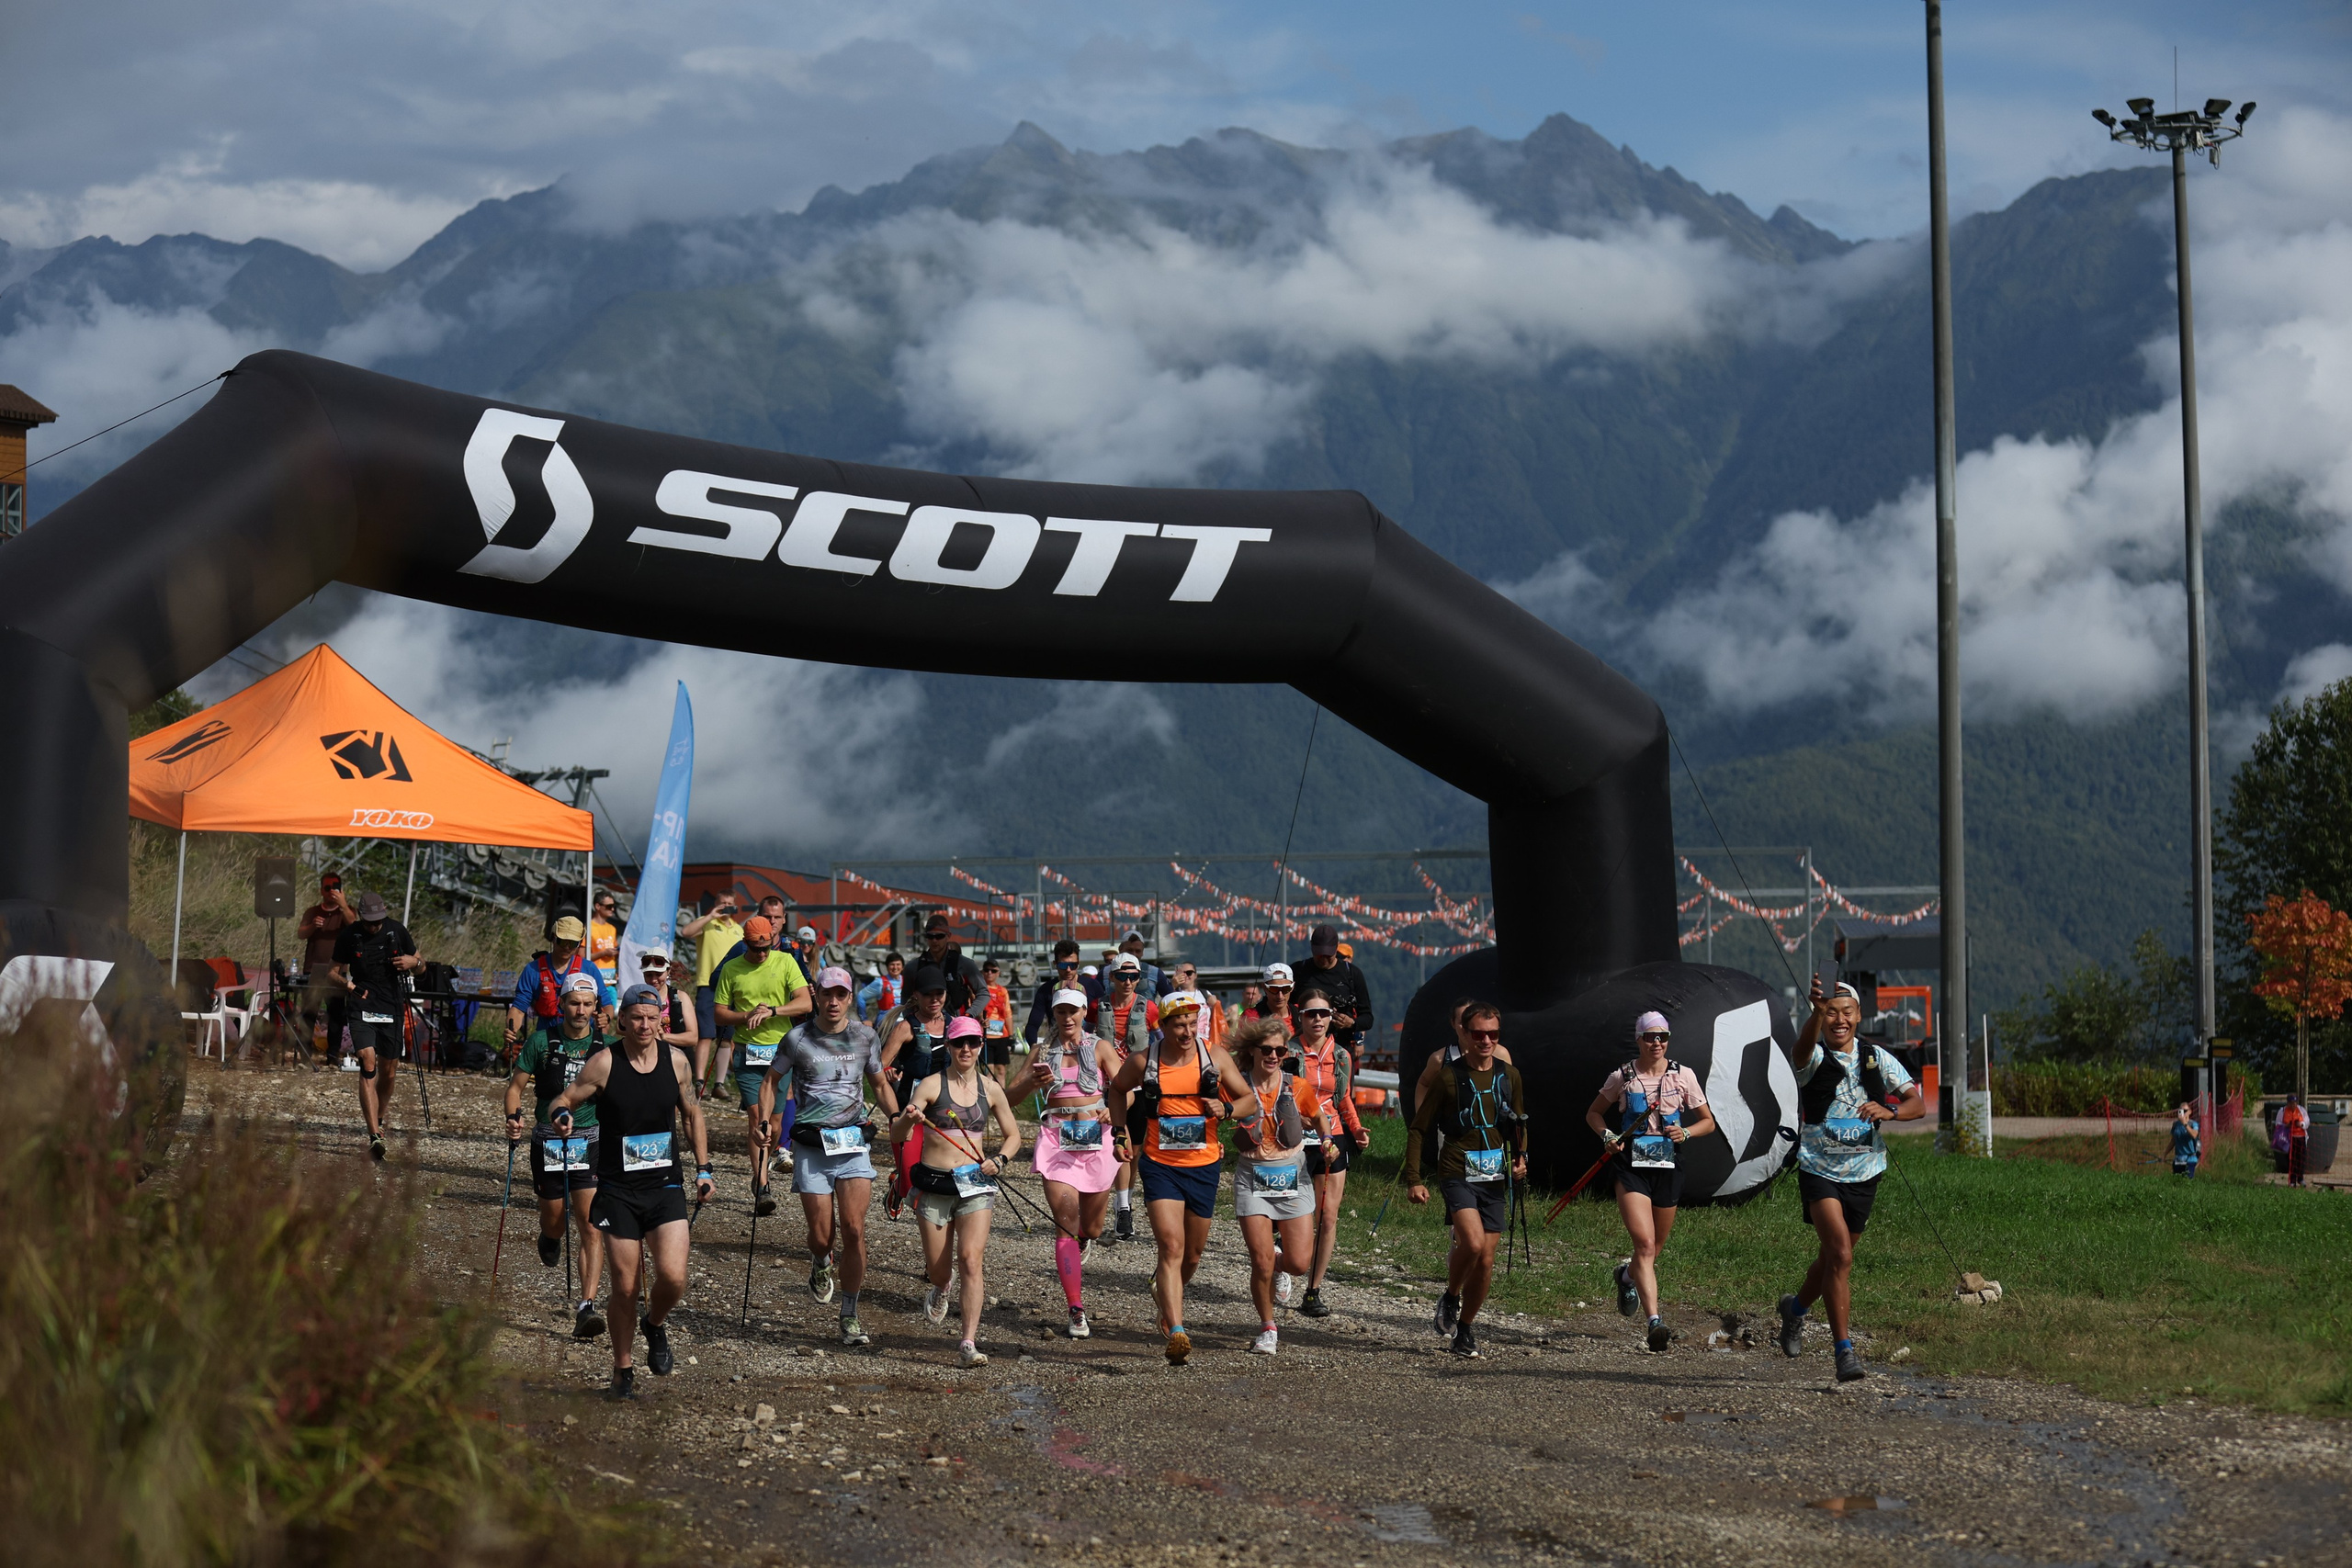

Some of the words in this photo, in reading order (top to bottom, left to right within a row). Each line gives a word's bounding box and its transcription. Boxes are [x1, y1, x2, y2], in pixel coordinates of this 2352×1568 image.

[627, 469, 1272, 603] SCOTT
[349, 809, 434, 829] YOKO
[754, 1048, 773, 1058] 126
[1069, 1129, 1090, 1140] 131
[1170, 1125, 1193, 1139] 154
[1836, 1127, 1860, 1141] 140
[634, 1143, 658, 1157] 123
[1644, 1144, 1664, 1156] 124
[1476, 1157, 1496, 1171] 134
[1264, 1174, 1286, 1187] 128
